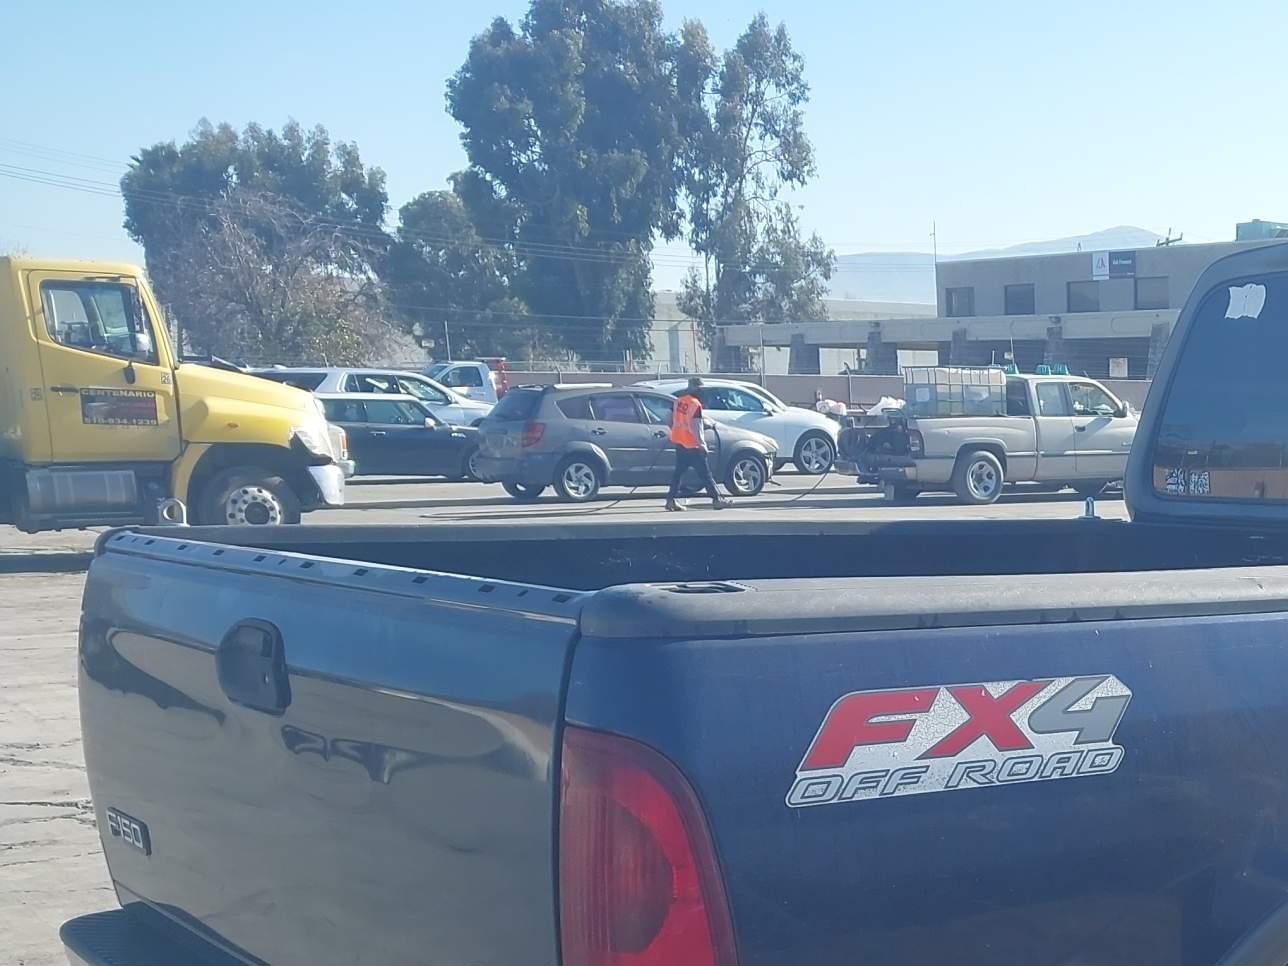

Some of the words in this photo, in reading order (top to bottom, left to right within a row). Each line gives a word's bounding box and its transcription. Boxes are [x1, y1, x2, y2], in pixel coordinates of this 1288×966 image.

[803, 675, 1131, 771] FX4
[789, 765, 928, 805] OFF
[946, 747, 1124, 788] ROAD
